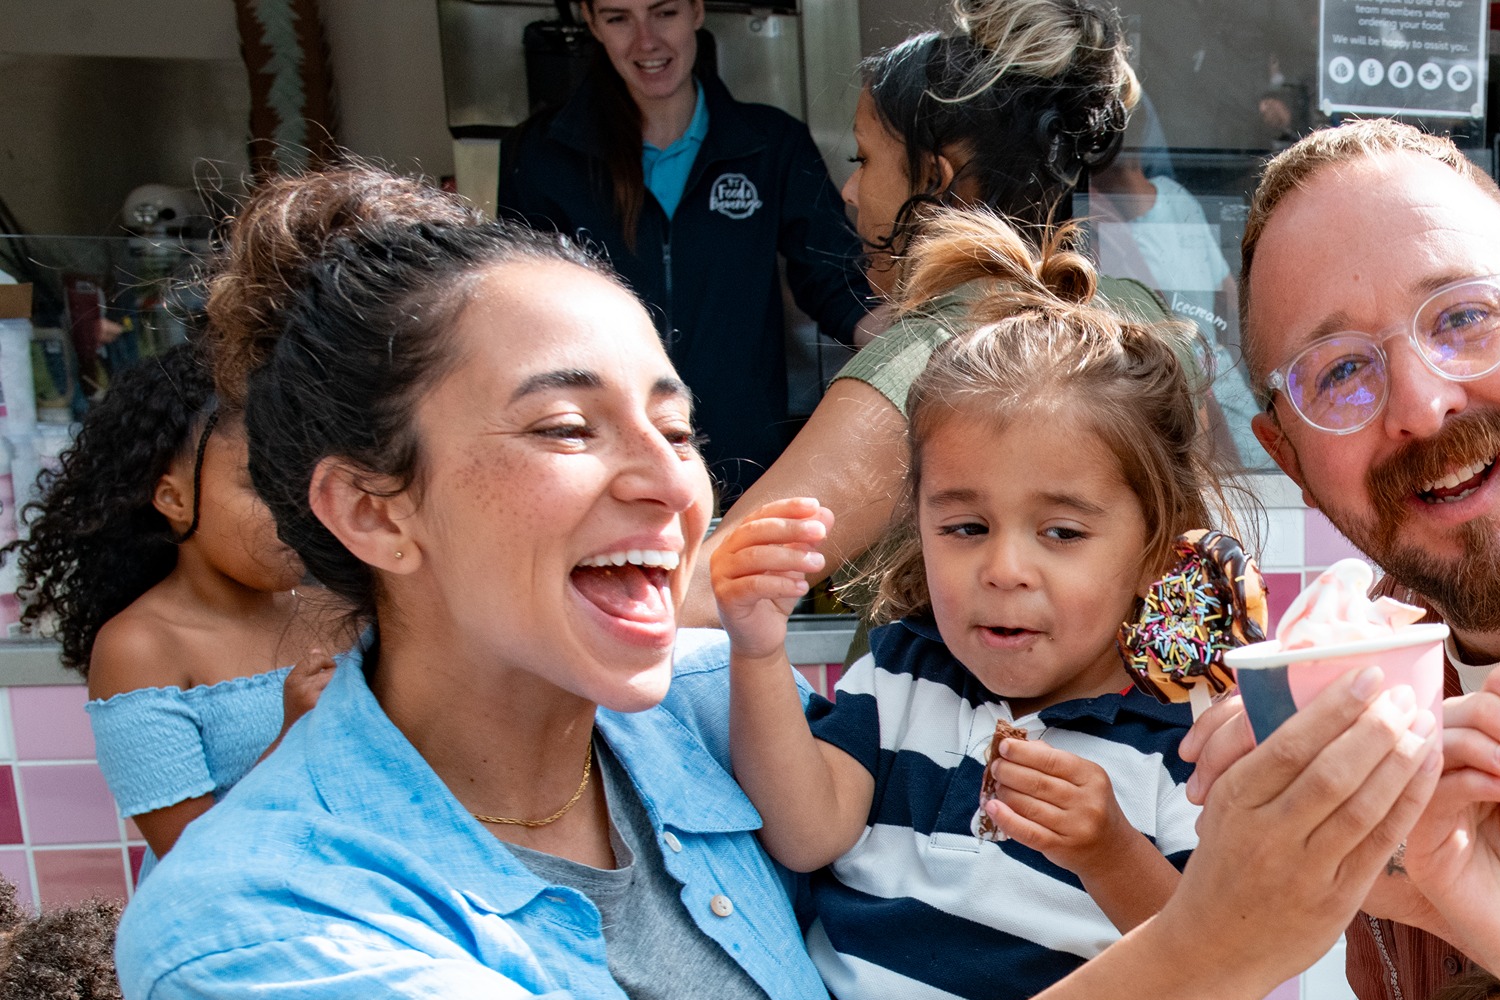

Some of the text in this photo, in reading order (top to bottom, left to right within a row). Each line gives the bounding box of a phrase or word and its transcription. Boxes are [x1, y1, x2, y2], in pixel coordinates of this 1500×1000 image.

[1355, 5, 1450, 19] team members when
[1358, 17, 1446, 31] ordering your food.
[1332, 34, 1470, 53] We will be happy to assist you.
